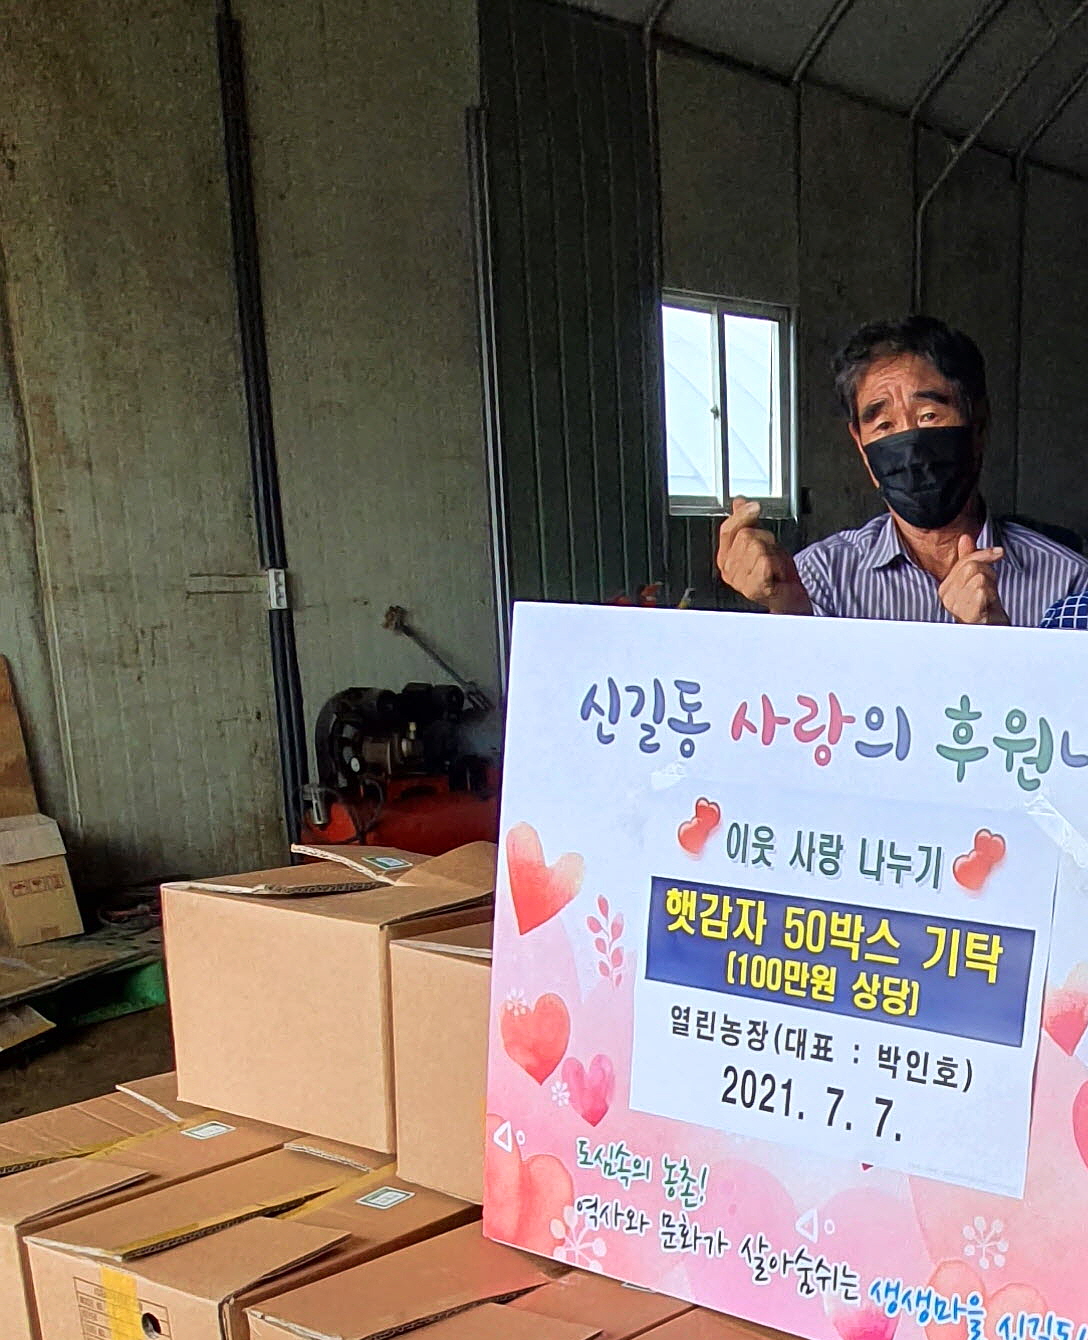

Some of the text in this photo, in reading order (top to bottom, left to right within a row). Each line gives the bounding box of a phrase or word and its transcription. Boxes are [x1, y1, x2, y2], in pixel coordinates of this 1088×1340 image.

[580, 677, 711, 758] 신길동
[731, 692, 911, 766] 사랑의
[726, 822, 943, 889] 이웃 사랑 나누기
[665, 888, 1003, 984] 햇감자 50박스 기탁
[721, 1065, 902, 1142] 2021. 7. 7.
[877, 1043, 973, 1093] 박인호)
[578, 1140, 707, 1208] 도심속의 농촌!
[576, 1197, 650, 1233] 역사와
[660, 1212, 729, 1256] 문화가
[740, 1236, 859, 1300] 살아숨쉬는
